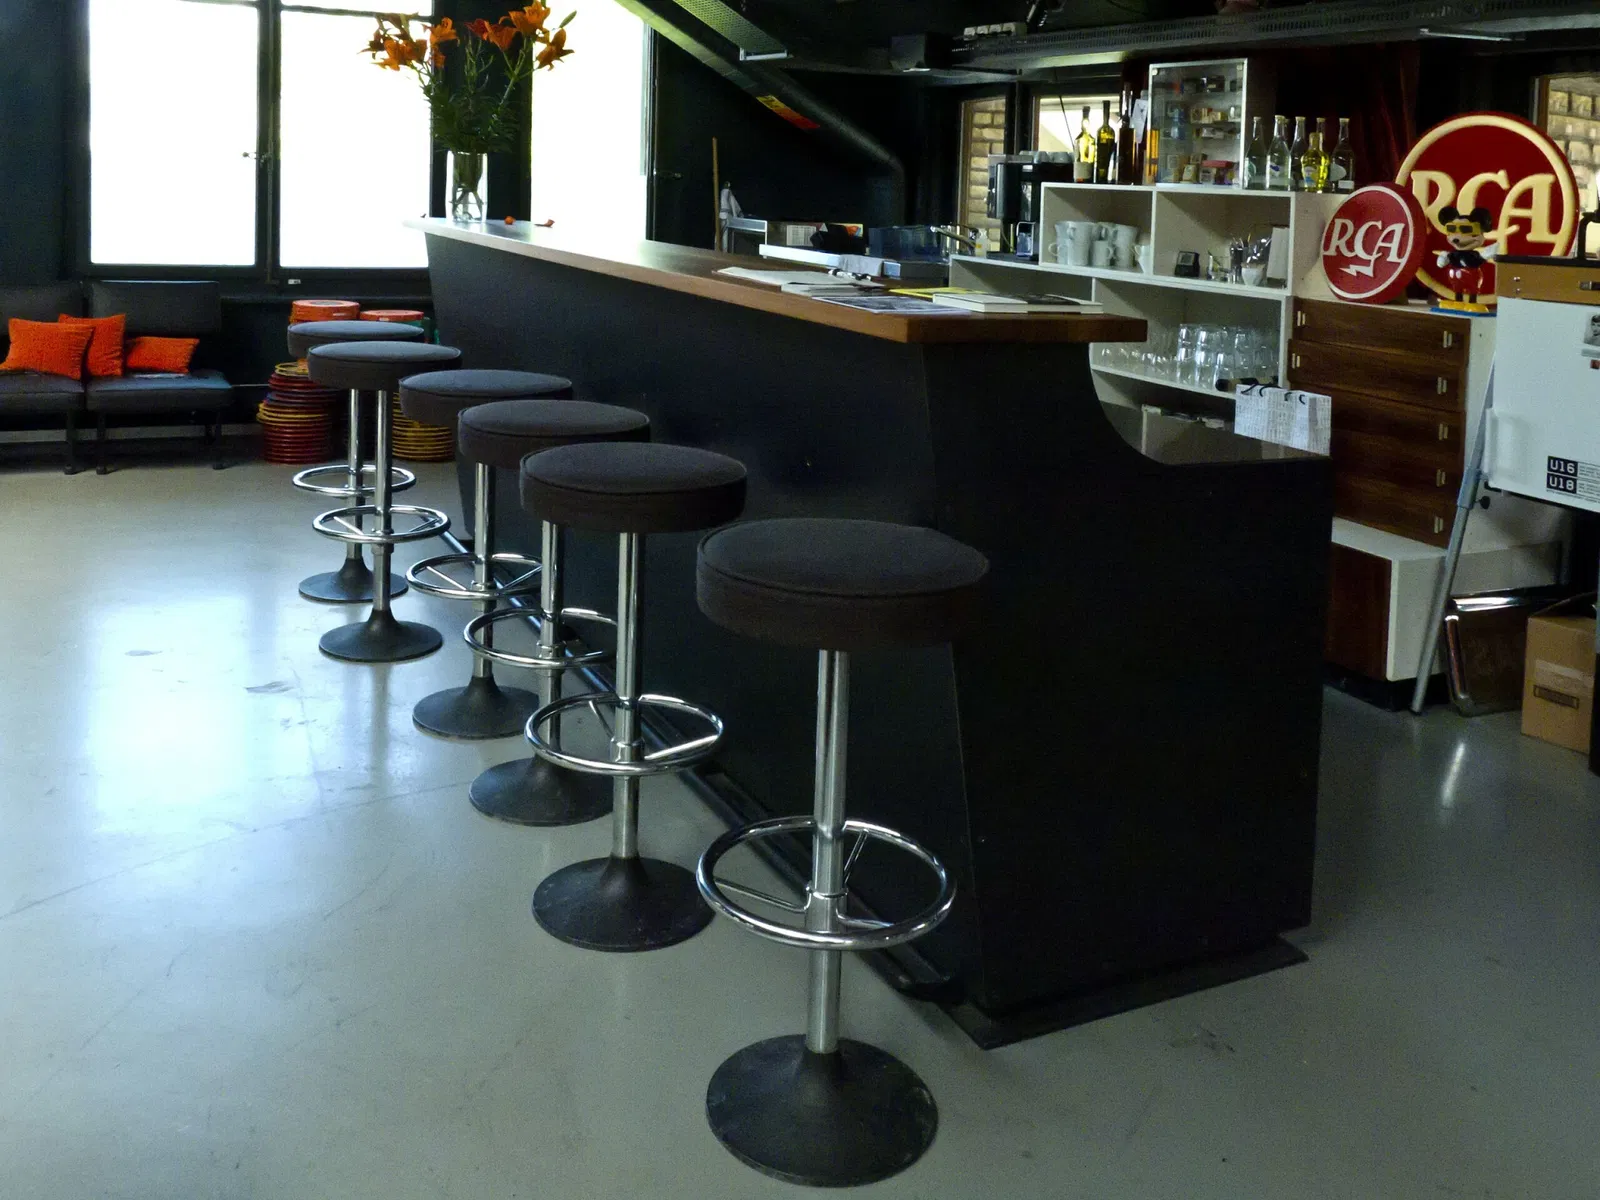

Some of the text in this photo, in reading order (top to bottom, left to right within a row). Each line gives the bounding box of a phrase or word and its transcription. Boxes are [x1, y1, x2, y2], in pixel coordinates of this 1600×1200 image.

[1411, 169, 1556, 246] RCA
[1322, 218, 1406, 266] RCA
[1550, 459, 1575, 474] U16
[1549, 475, 1574, 491] U18
